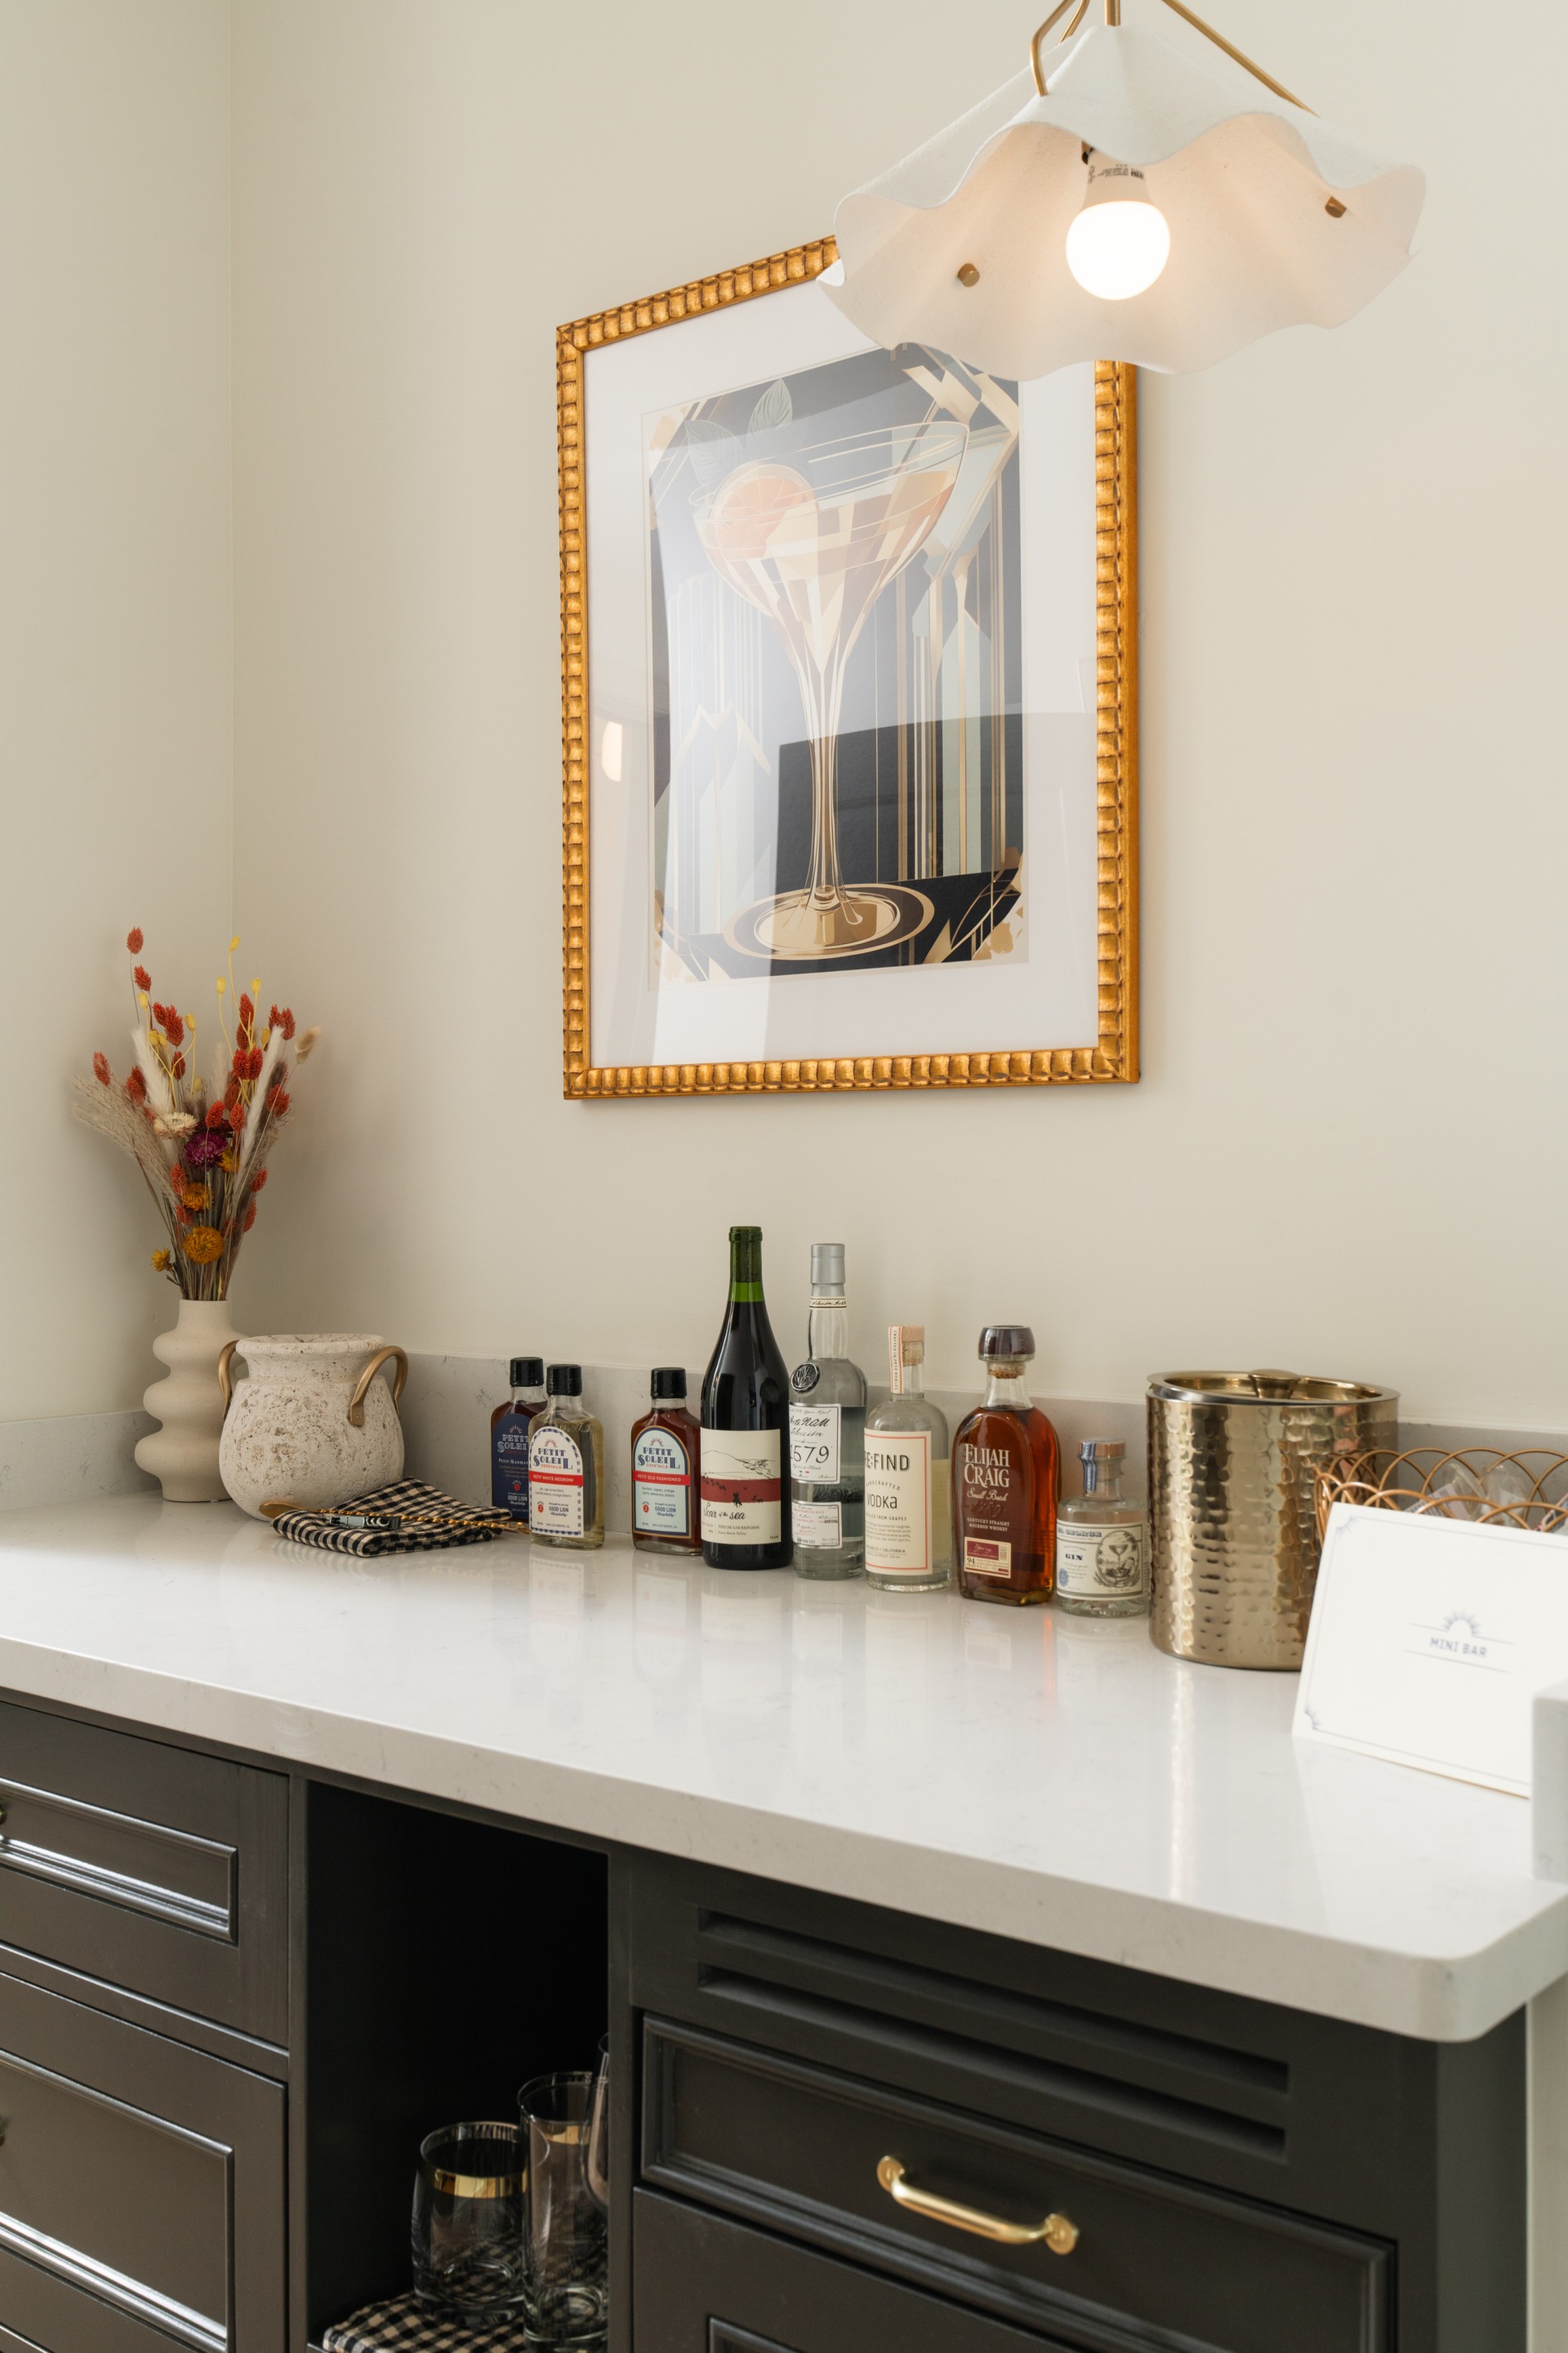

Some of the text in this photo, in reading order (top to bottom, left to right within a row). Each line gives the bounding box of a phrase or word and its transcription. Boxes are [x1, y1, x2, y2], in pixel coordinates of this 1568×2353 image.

[497, 1441, 528, 1453] SOLEI
[538, 1447, 566, 1456] PETIT
[643, 1446, 673, 1455] PETIT
[533, 1455, 573, 1469] SOLEIL
[638, 1454, 680, 1469] SOLEIL
[964, 1443, 1010, 1468] ELIJAH
[964, 1463, 1010, 1488] CRAIG
[966, 1487, 1009, 1501] Small Batch
[703, 1501, 717, 1518] Scar
[728, 1512, 746, 1520] sea
[1065, 1553, 1084, 1561] GIN
[1429, 1637, 1487, 1658] MINI BAR
